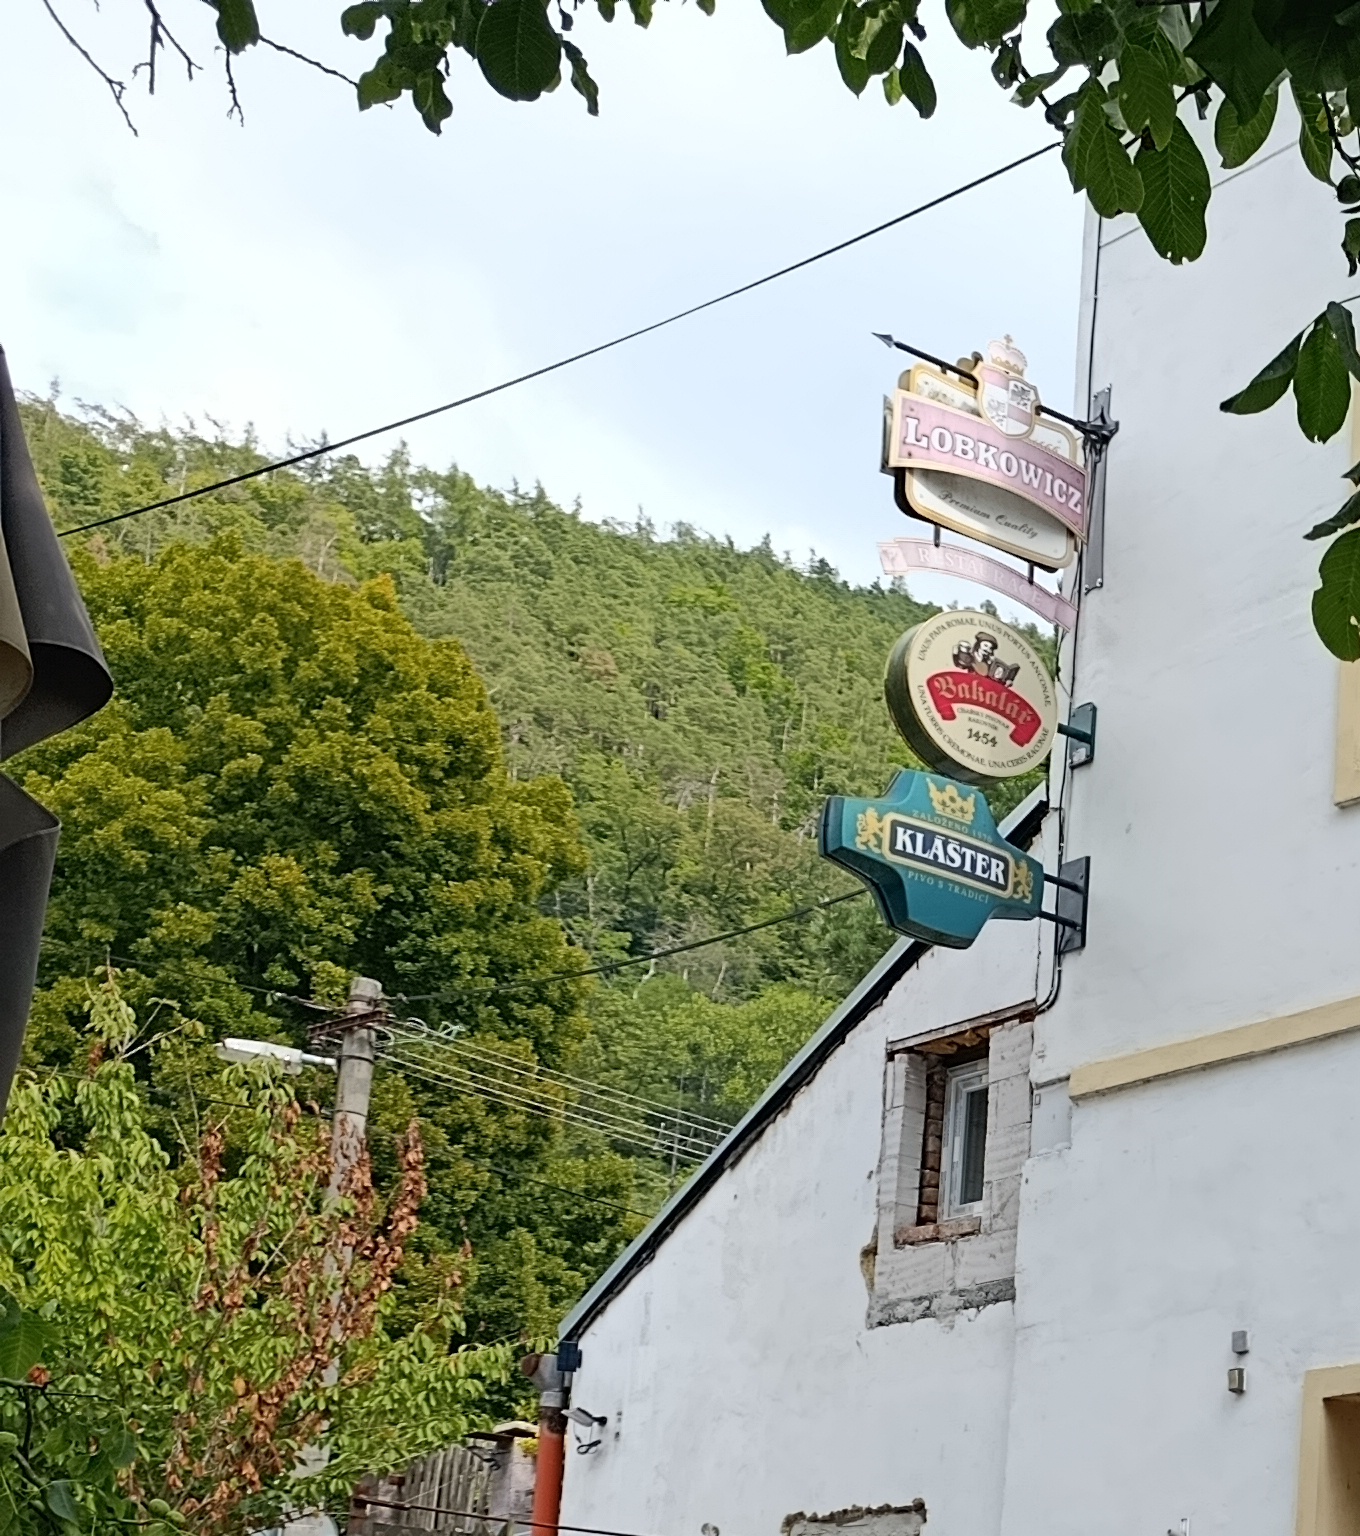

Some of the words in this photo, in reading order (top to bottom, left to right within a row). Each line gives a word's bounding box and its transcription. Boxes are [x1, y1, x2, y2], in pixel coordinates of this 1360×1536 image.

[905, 417, 1082, 514] LOBKOWICZ
[939, 490, 991, 520] Premium
[996, 514, 1039, 539] Quality
[918, 547, 1043, 605] RESTAURACE
[930, 624, 947, 641] PAPA
[978, 620, 1003, 634] UNUS
[1003, 630, 1031, 660] PORTUS
[934, 676, 1034, 725] Bakalář
[967, 728, 998, 748] 1454
[912, 809, 968, 834] ZALOŽENO
[895, 827, 1005, 886] KLÁŠTER
[908, 871, 934, 885] PIVO
[948, 883, 989, 904] TRADICÍ
